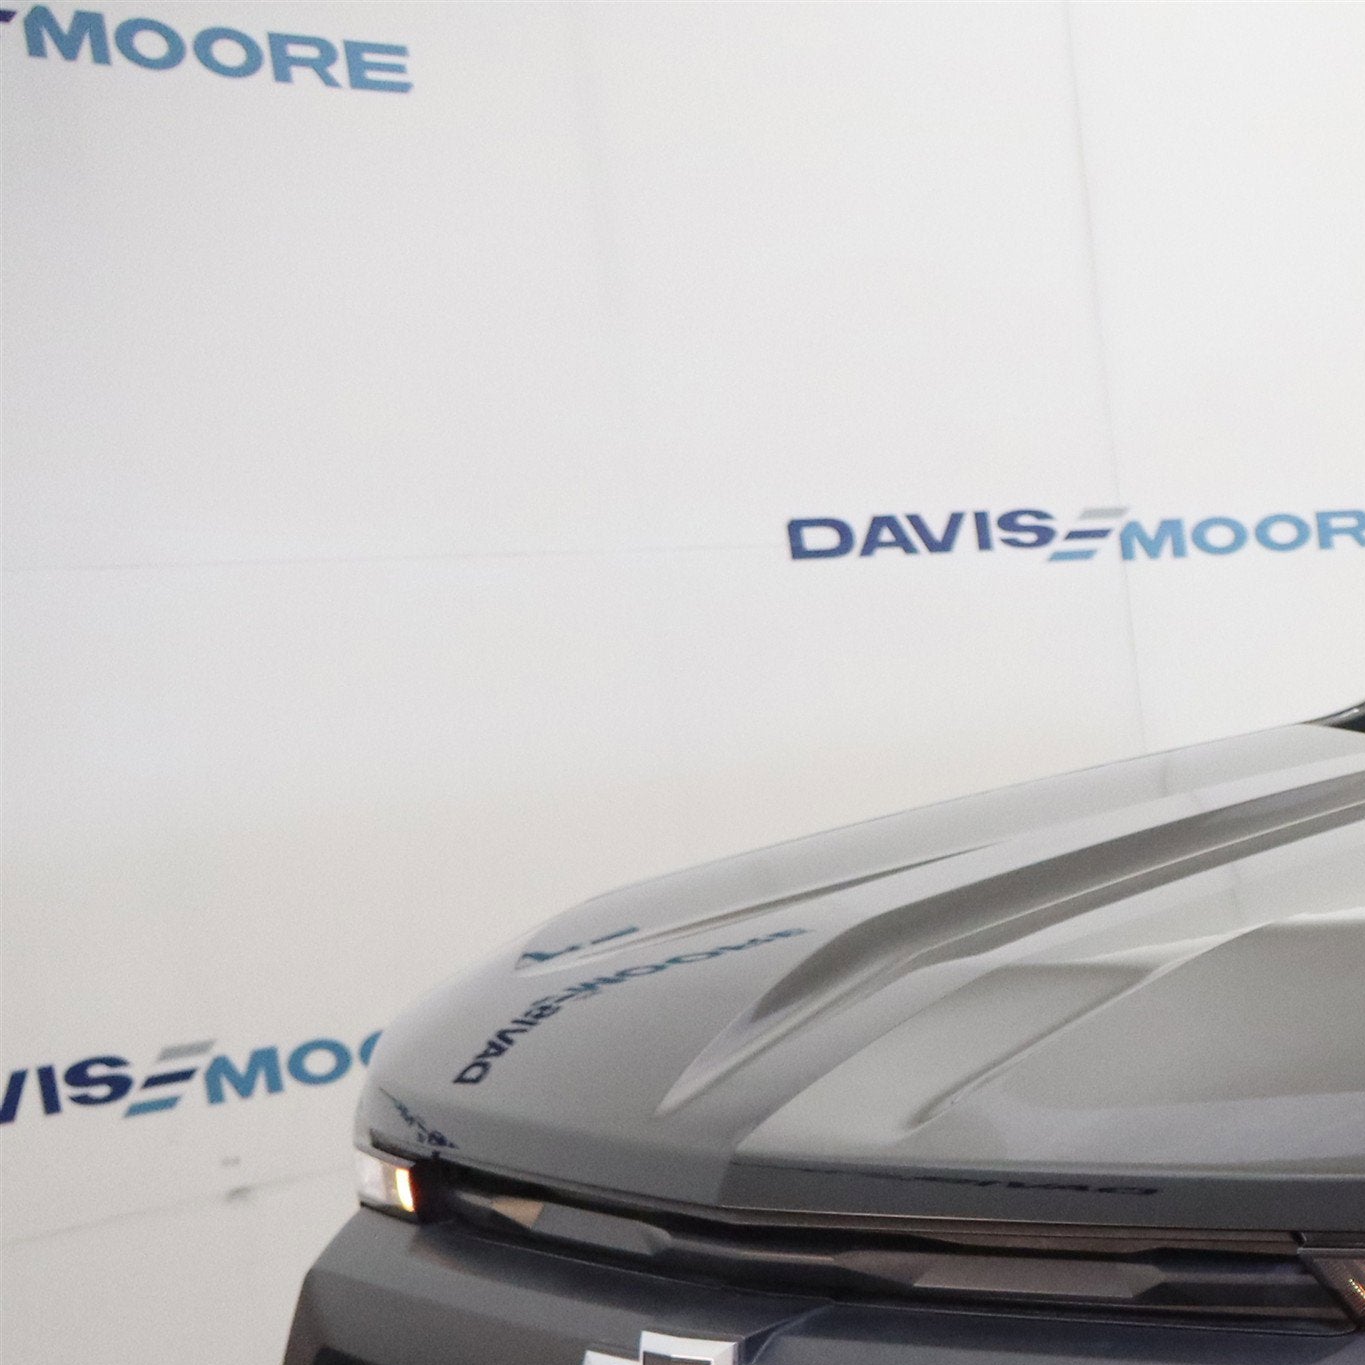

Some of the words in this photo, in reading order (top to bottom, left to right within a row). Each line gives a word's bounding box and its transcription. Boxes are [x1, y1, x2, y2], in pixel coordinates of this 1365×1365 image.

[22, 5, 414, 94] MOORE
[786, 508, 1058, 560] DAVIS
[204, 1029, 384, 1107] MO
